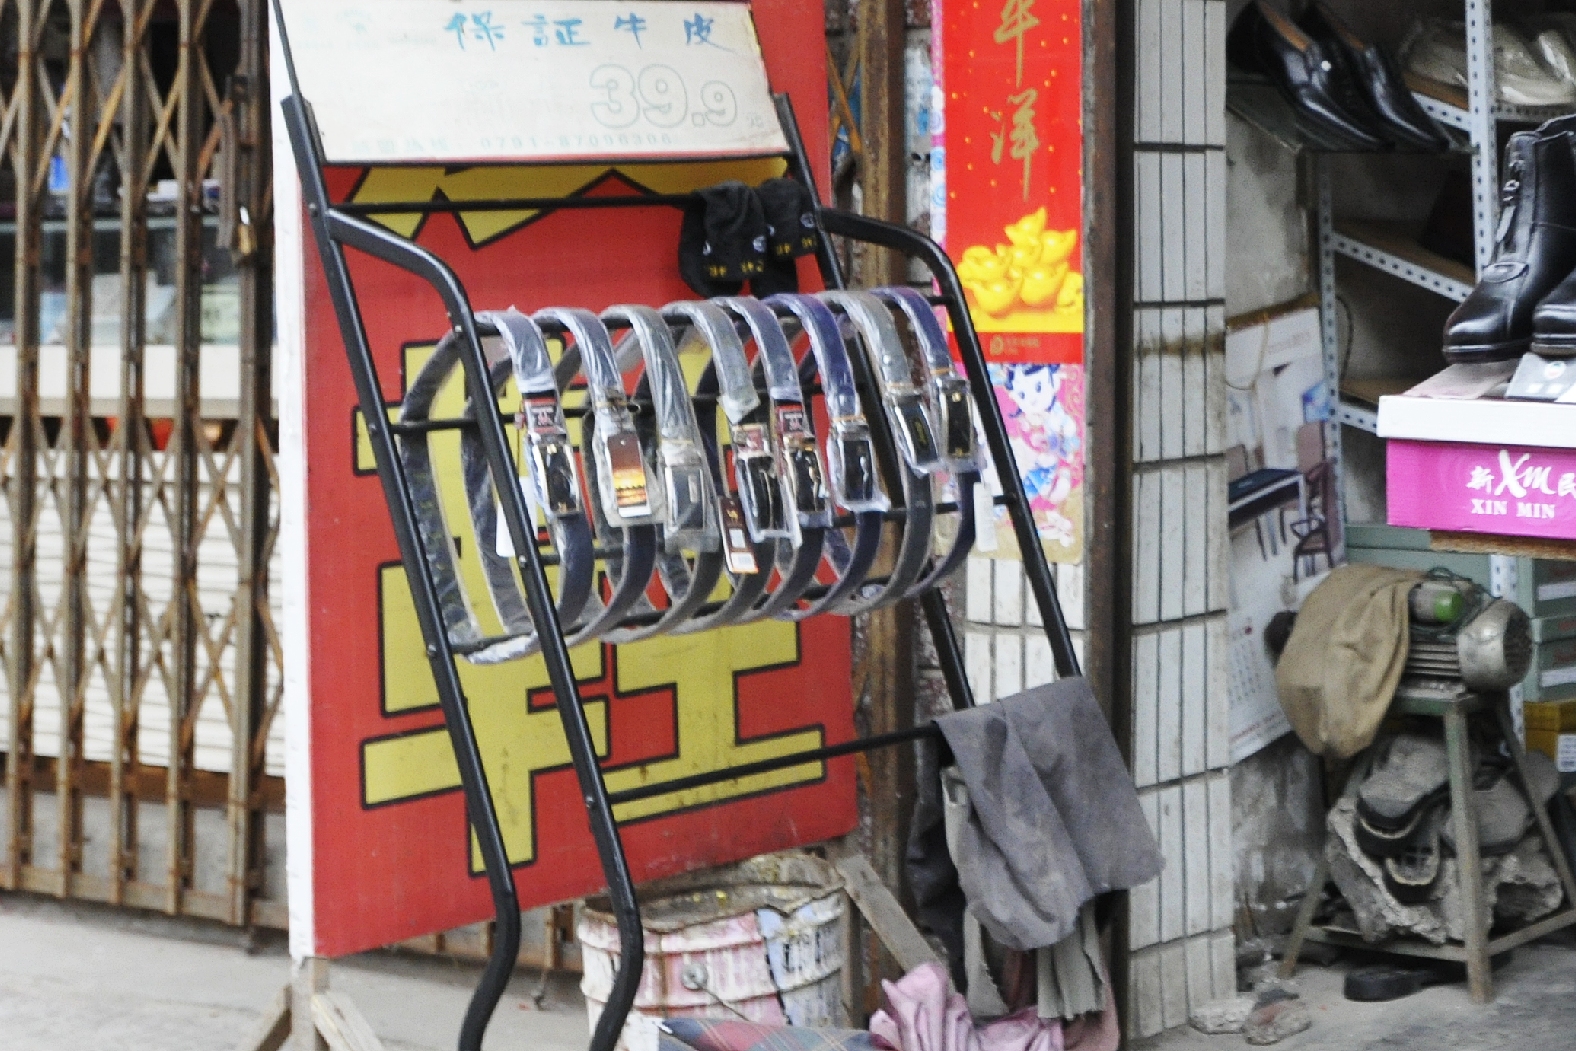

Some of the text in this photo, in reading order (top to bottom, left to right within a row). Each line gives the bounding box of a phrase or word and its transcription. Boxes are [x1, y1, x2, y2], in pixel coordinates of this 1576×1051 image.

[588, 63, 738, 129] 39.9
[1471, 498, 1556, 519] XIN MIN
